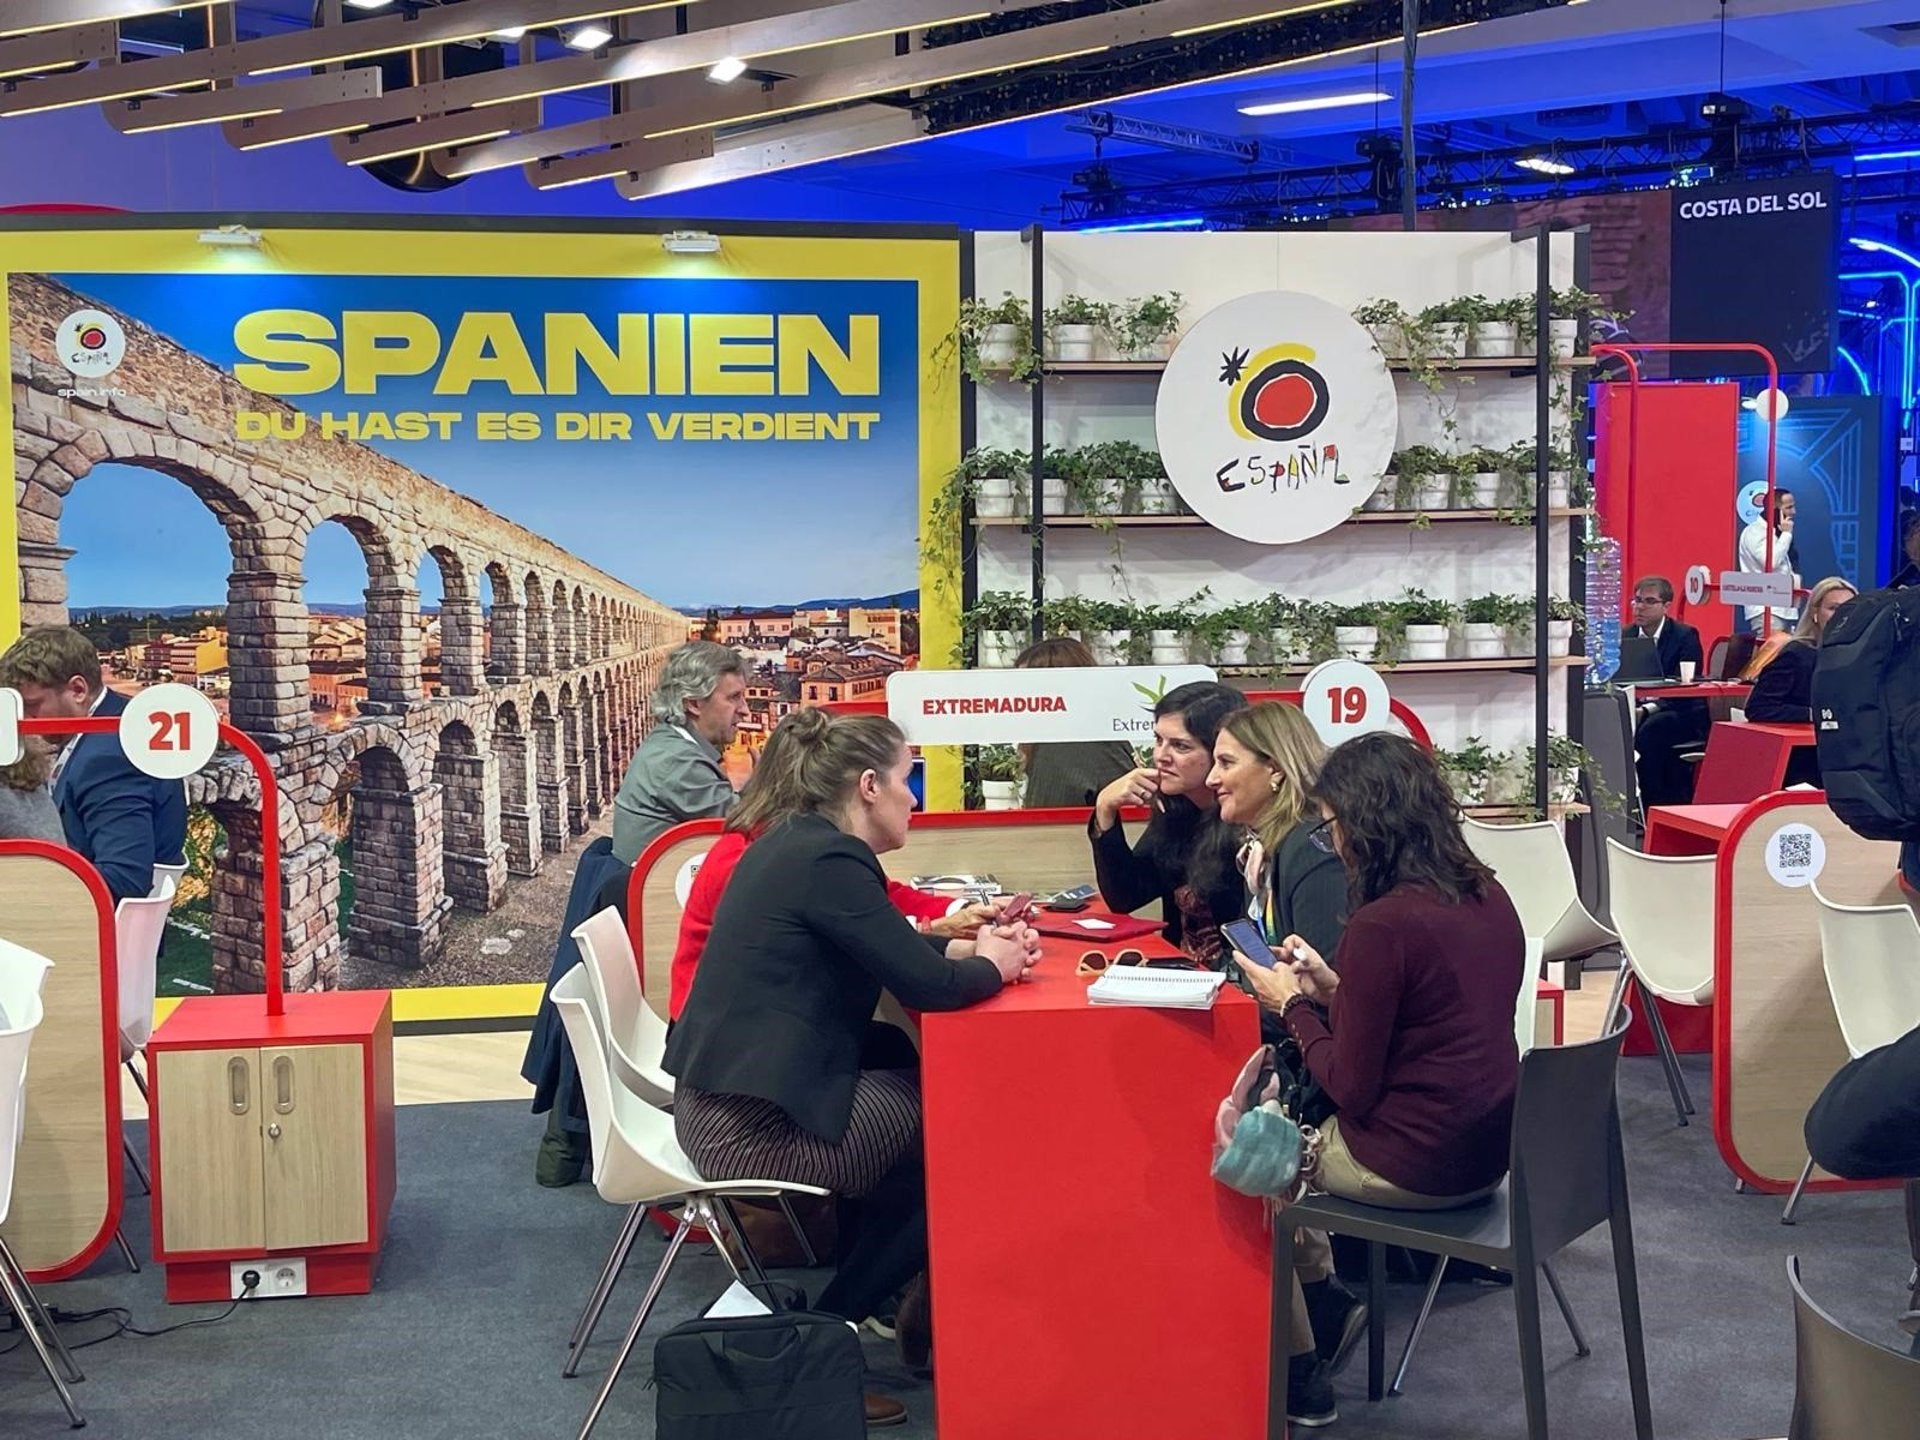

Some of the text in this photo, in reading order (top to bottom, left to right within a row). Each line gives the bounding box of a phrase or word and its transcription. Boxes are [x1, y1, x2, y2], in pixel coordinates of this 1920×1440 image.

[1679, 191, 1828, 219] COSTA DEL SOL
[233, 309, 880, 396] SPANIEN
[236, 411, 881, 441] DU HAST ES DIR VERDIENT
[1216, 440, 1351, 494] ESPAÑA
[1689, 576, 1700, 594] 10
[922, 696, 1068, 715] EXTREMADURA
[1327, 686, 1368, 724] 19
[148, 710, 191, 751] 21
